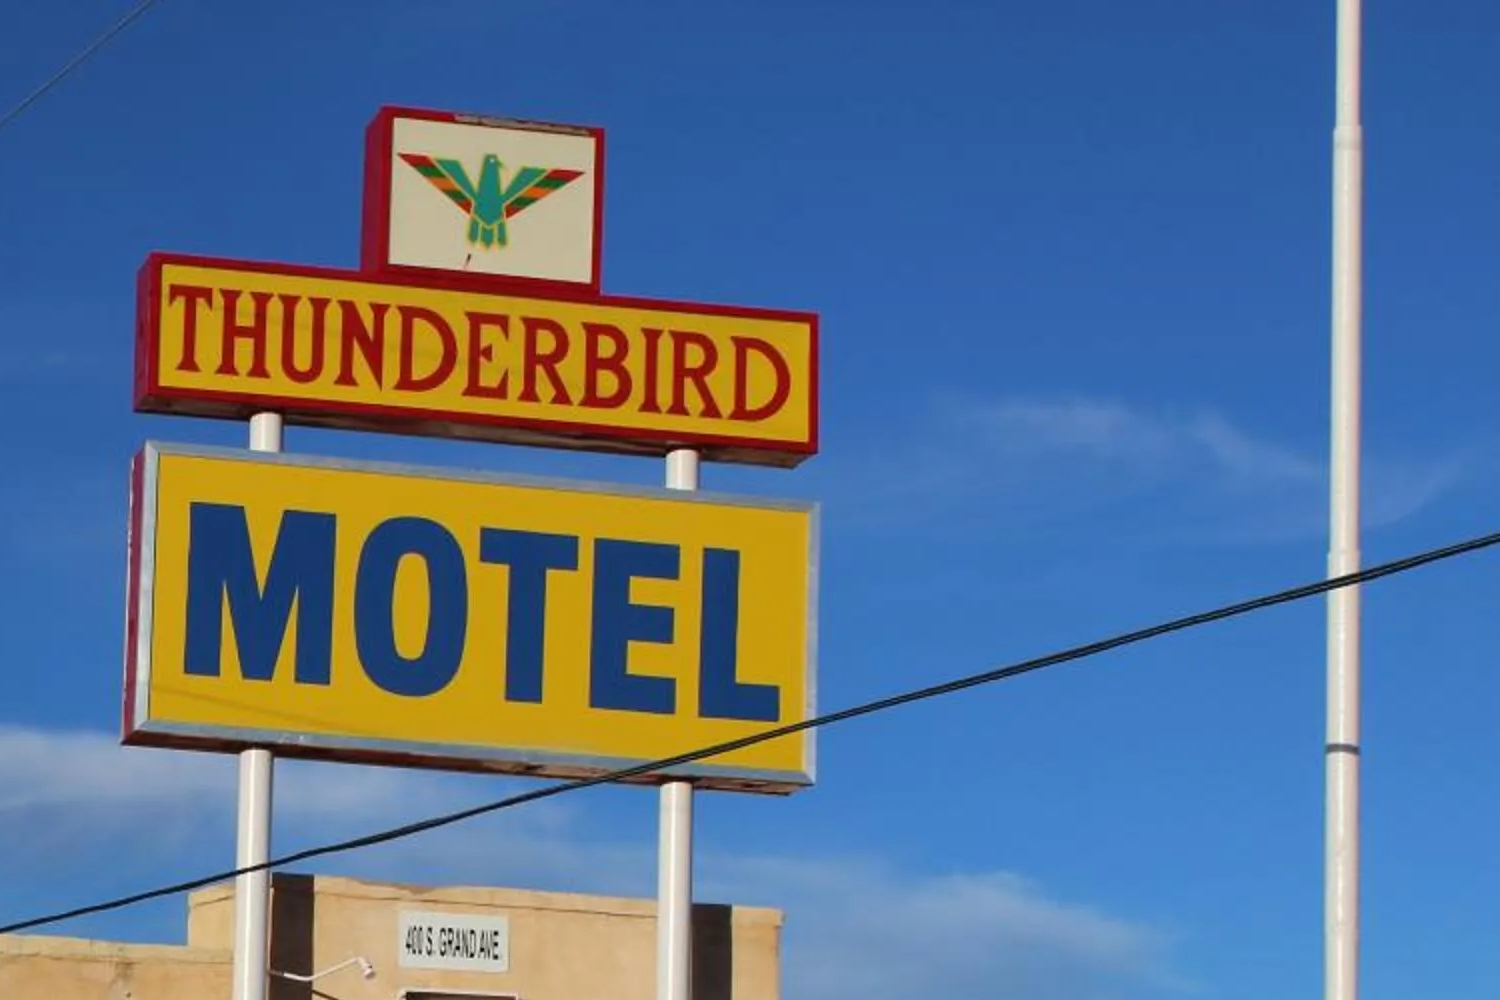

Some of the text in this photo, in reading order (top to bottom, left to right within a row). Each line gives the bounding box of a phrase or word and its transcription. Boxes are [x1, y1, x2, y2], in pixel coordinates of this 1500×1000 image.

[168, 283, 791, 422] THUNDERBIRD
[183, 501, 781, 723] MOTEL
[405, 925, 423, 955] 400
[439, 927, 477, 959] GRAND
